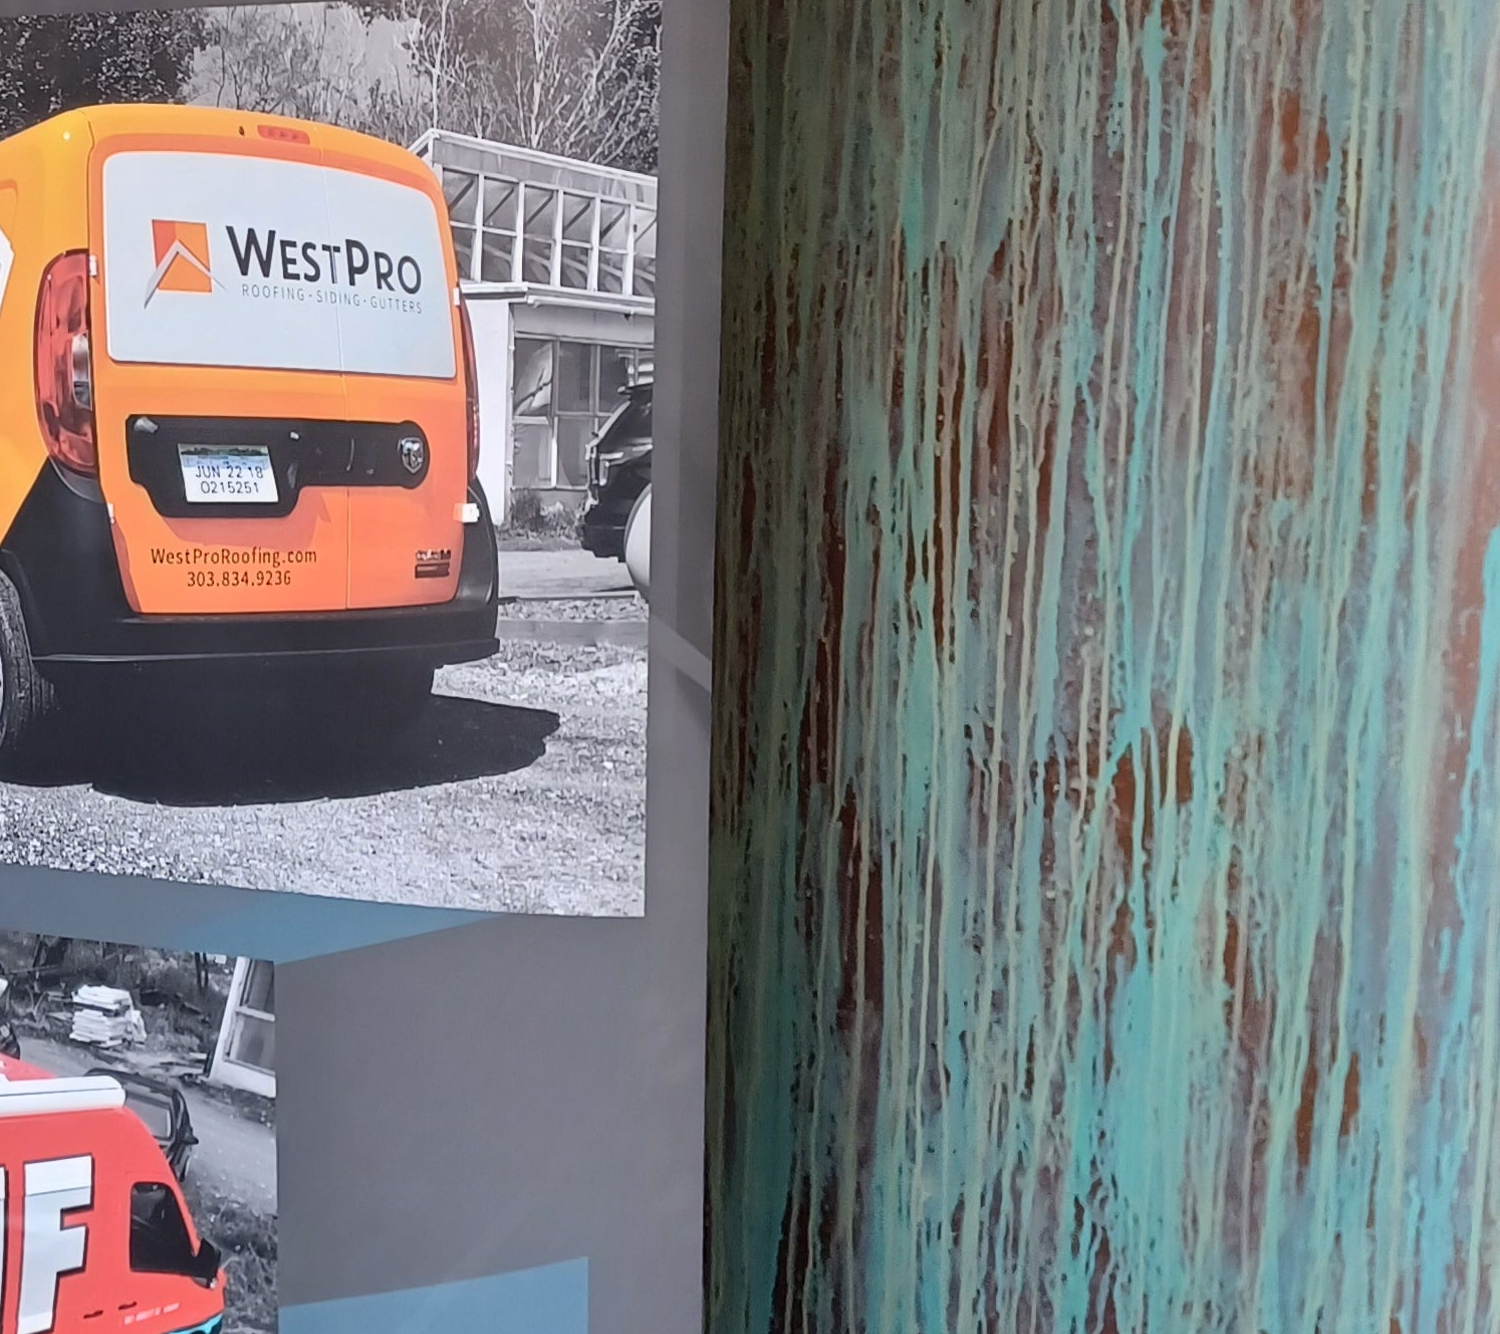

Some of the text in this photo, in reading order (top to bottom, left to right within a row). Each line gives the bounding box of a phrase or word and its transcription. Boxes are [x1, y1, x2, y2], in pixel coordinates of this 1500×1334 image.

[242, 283, 422, 314] ROOFING SIDING GUTTERS
[196, 465, 264, 479] JUN 22 18
[151, 547, 318, 568] WestProRoofing.com
[187, 570, 292, 587] 303.834.9236
